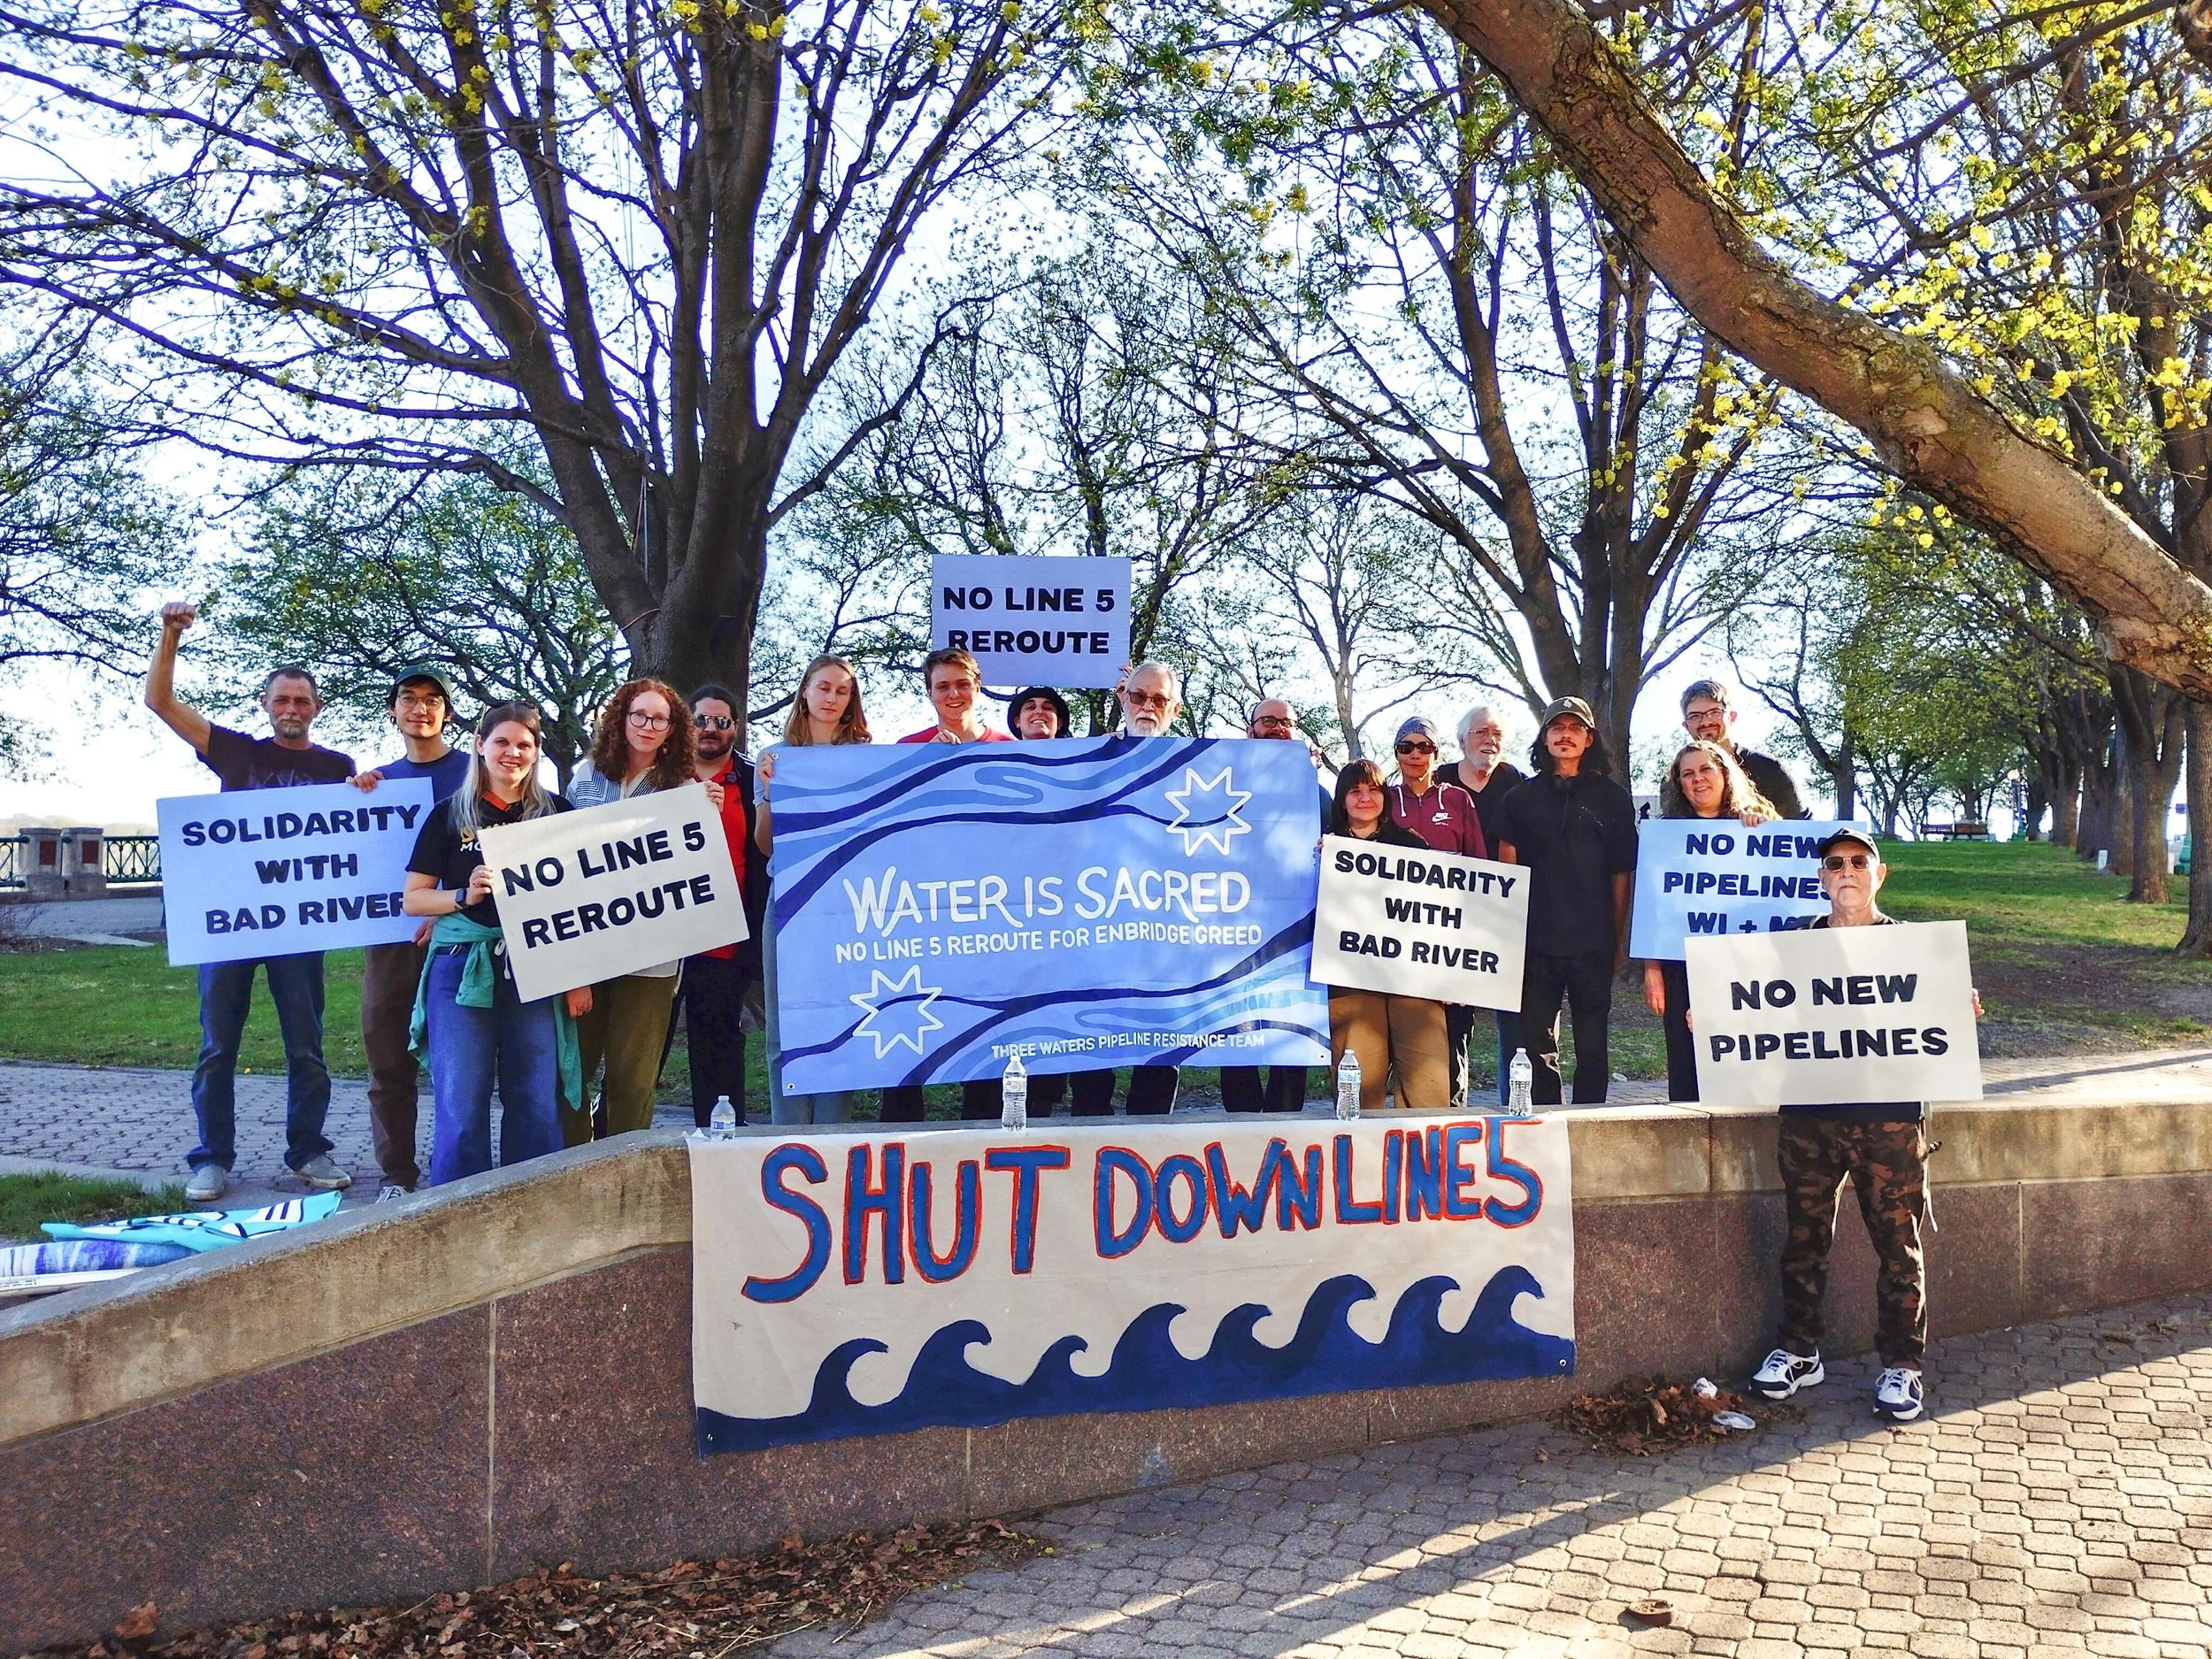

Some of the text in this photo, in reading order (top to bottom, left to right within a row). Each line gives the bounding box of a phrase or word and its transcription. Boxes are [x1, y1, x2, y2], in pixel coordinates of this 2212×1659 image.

[943, 587, 1116, 613] NO LINE 5
[948, 629, 1110, 655] REROUTE
[181, 803, 422, 847] SOLIDARITY
[501, 821, 705, 897] NO LINE 5
[1686, 833, 1823, 859] NO NEW
[254, 853, 358, 885] WITH
[1334, 850, 1517, 898] SOLIDARITY
[1663, 872, 1832, 900] PIPELINE
[205, 904, 286, 934] BAD
[521, 872, 715, 949] REROUTE
[842, 865, 1251, 938] WATER IS SACRED
[1385, 897, 1463, 930] WITH
[1687, 911, 1728, 935] WI
[835, 921, 1263, 963] NO LINE 5 REROUTE FOR ENBRIDGE GREED
[1339, 931, 1499, 974] BAD RIVER
[1730, 973, 1917, 1010] NO NEW
[991, 1032, 1265, 1059] THREE WATERS PIPELINE RESISTANCE TEAM
[1709, 1026, 1948, 1062] PIPELINES
[741, 1116, 1545, 1304] SHUT DOWN LINE 5
